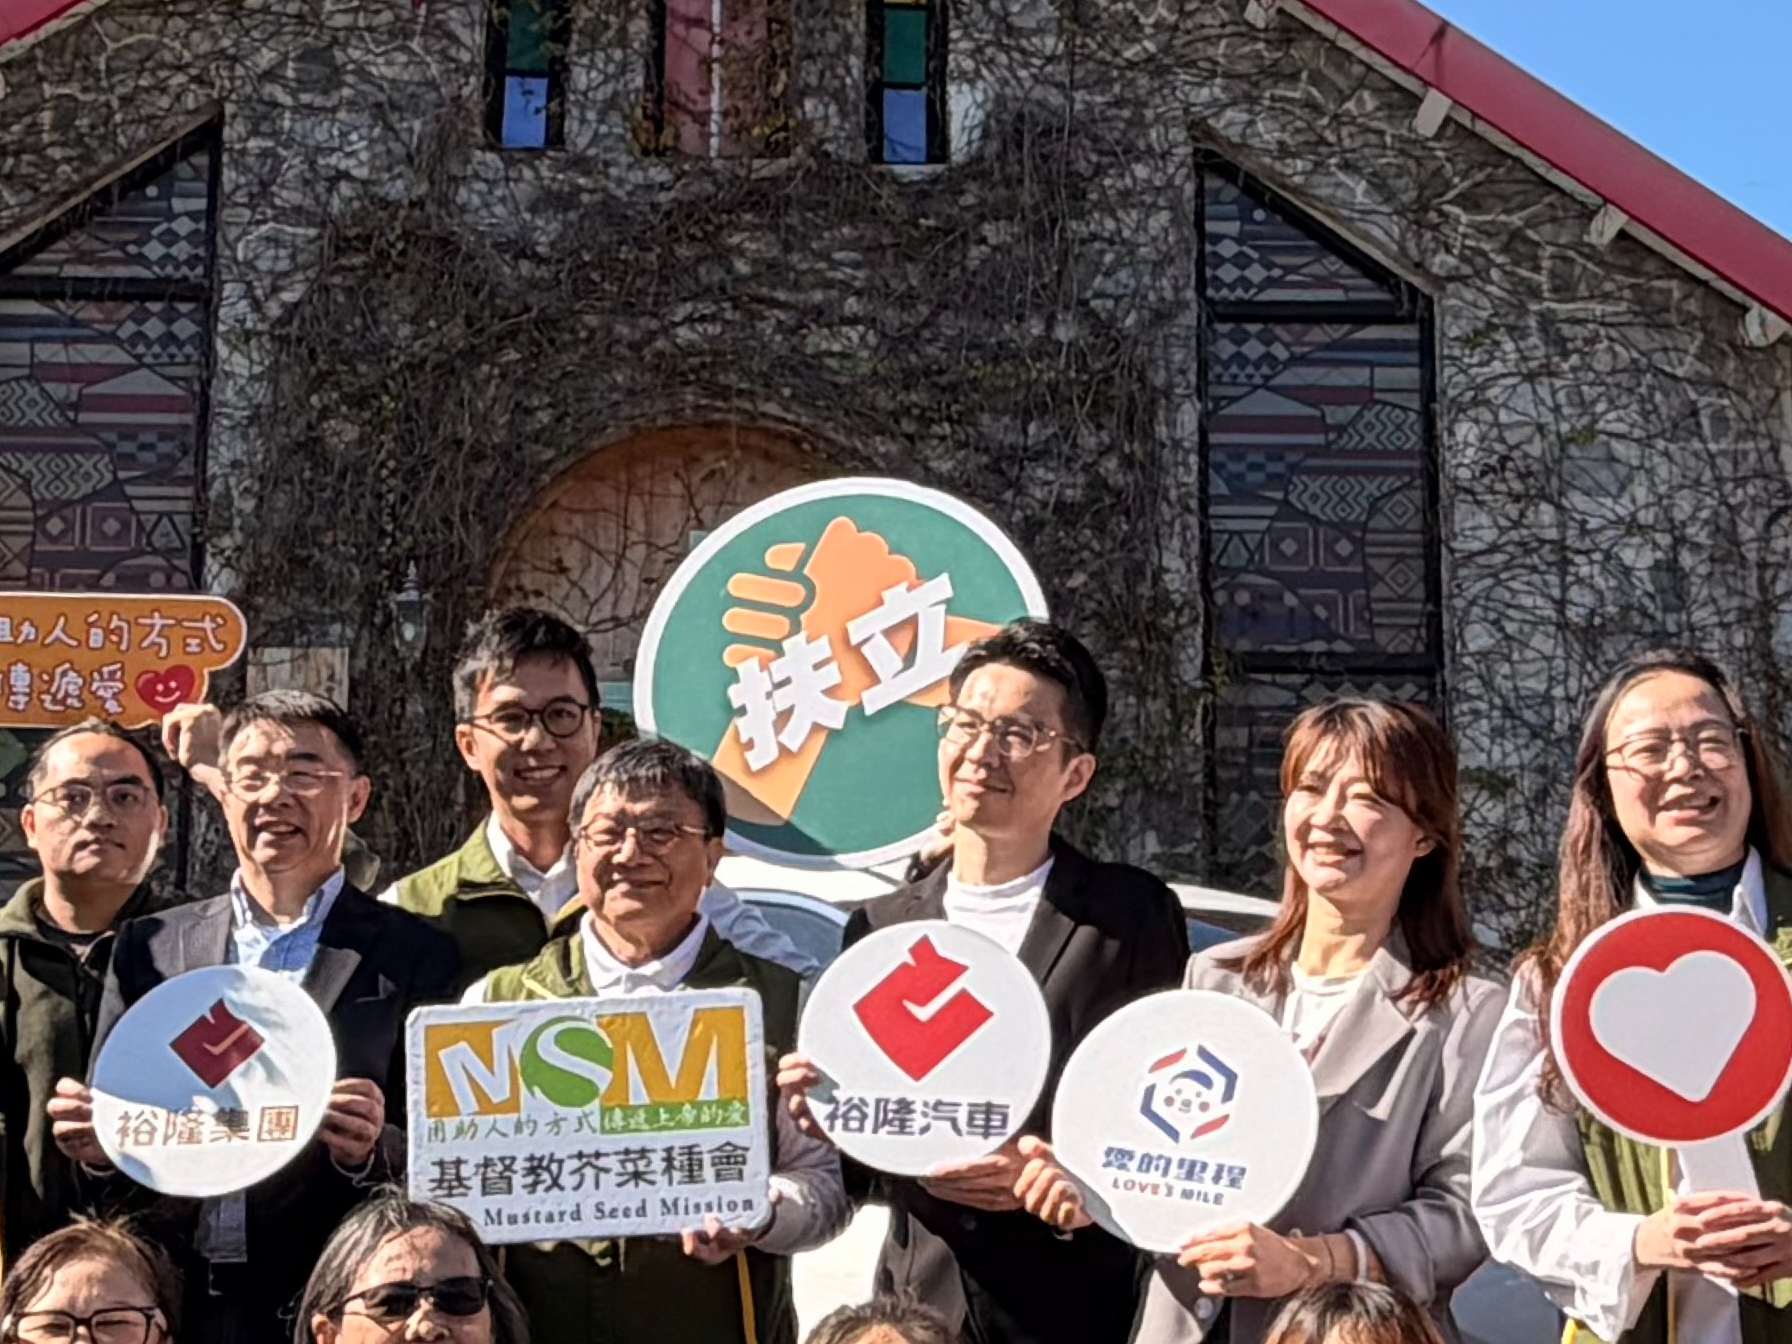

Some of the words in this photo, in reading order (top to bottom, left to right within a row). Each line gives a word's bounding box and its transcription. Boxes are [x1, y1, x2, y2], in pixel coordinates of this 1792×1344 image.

[727, 573, 971, 771] 扶立
[116, 1105, 300, 1149] 裕隆集團
[823, 1089, 1011, 1141] 裕隆汽車
[428, 1140, 750, 1198] 基督教芥菜種會
[1102, 1146, 1247, 1190] 愛的里程
[484, 1200, 582, 1226] Mustard
[593, 1199, 648, 1220] Seed
[660, 1195, 754, 1217] Mission
[1180, 1188, 1224, 1206] MILE
